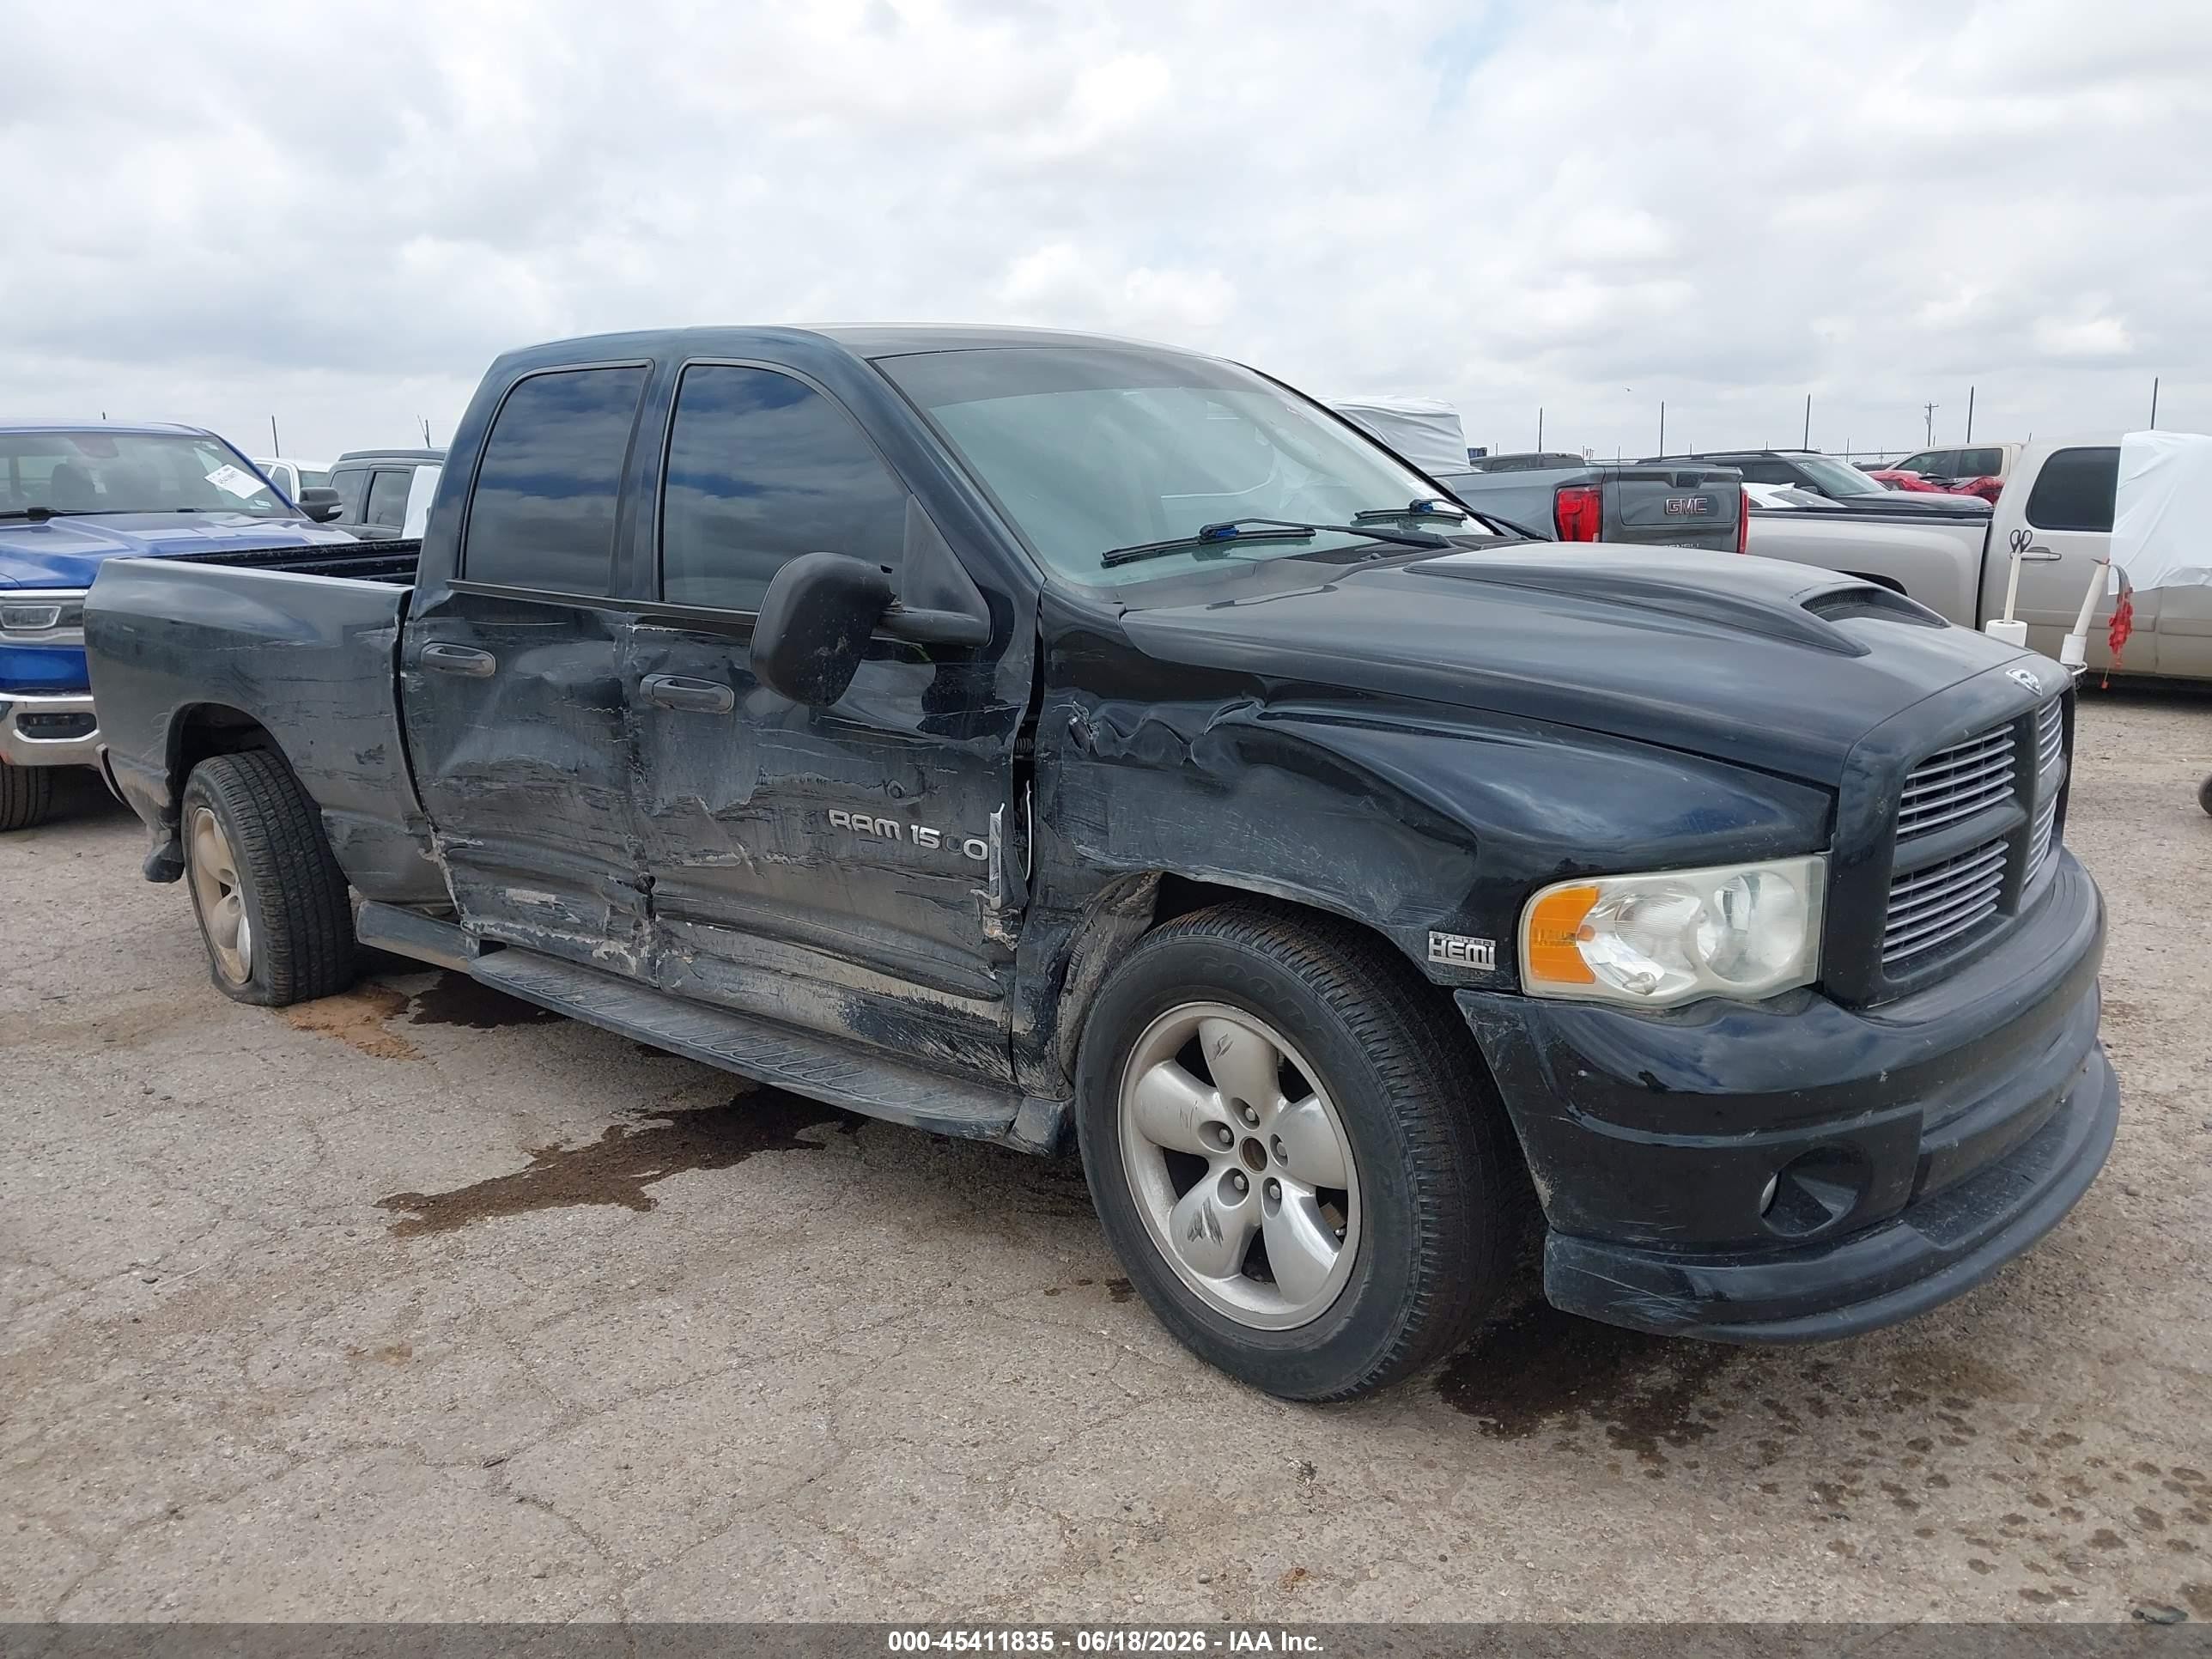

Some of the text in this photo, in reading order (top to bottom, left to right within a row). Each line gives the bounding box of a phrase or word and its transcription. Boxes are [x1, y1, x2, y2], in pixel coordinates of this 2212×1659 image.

[1665, 496, 1708, 515] GMC
[828, 809, 902, 841] RAM
[1429, 937, 1496, 964] HEMI
